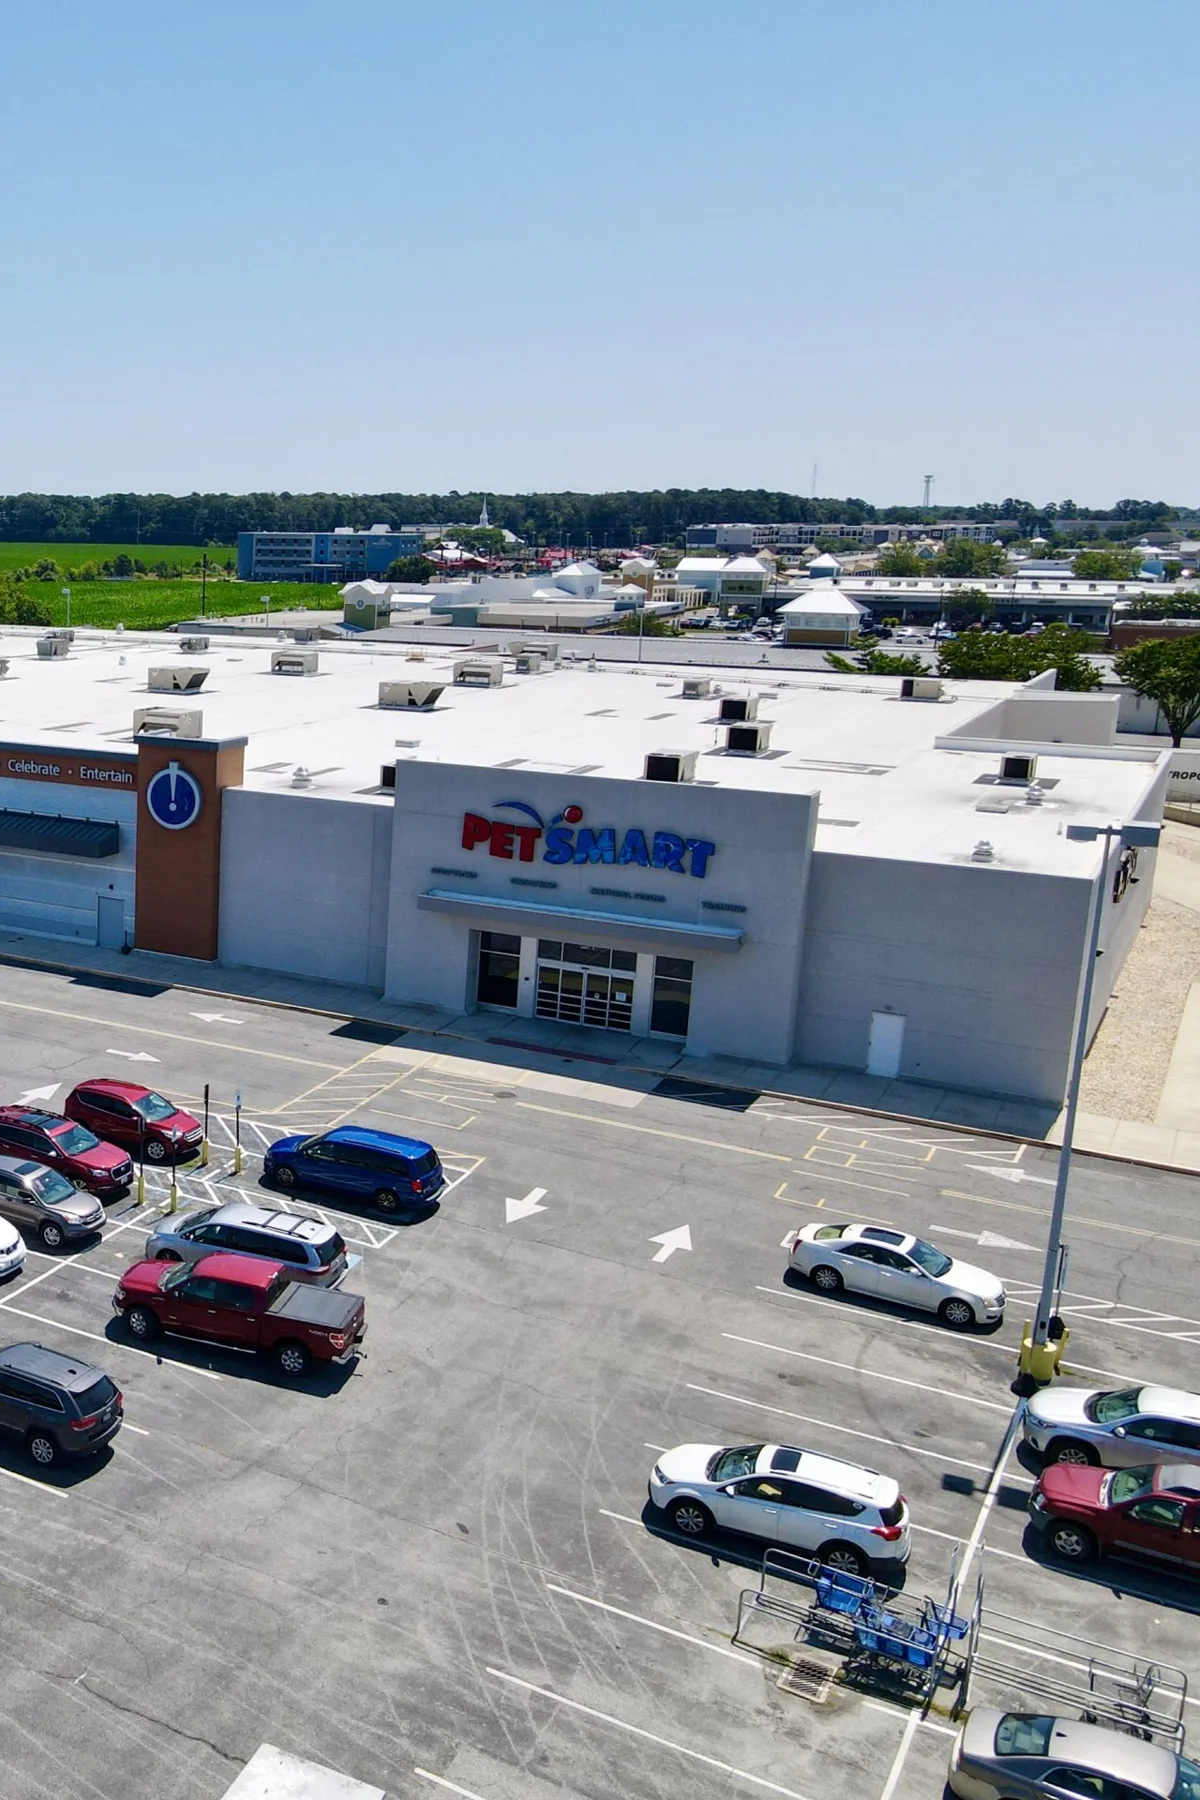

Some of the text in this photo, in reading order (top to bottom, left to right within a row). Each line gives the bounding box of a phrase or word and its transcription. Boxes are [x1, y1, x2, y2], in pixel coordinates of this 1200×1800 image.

[7, 758, 60, 776] Celebrate
[79, 766, 133, 783] Entertain
[461, 811, 715, 879] PETSMART
[772, 1126, 937, 1225] FIRE
